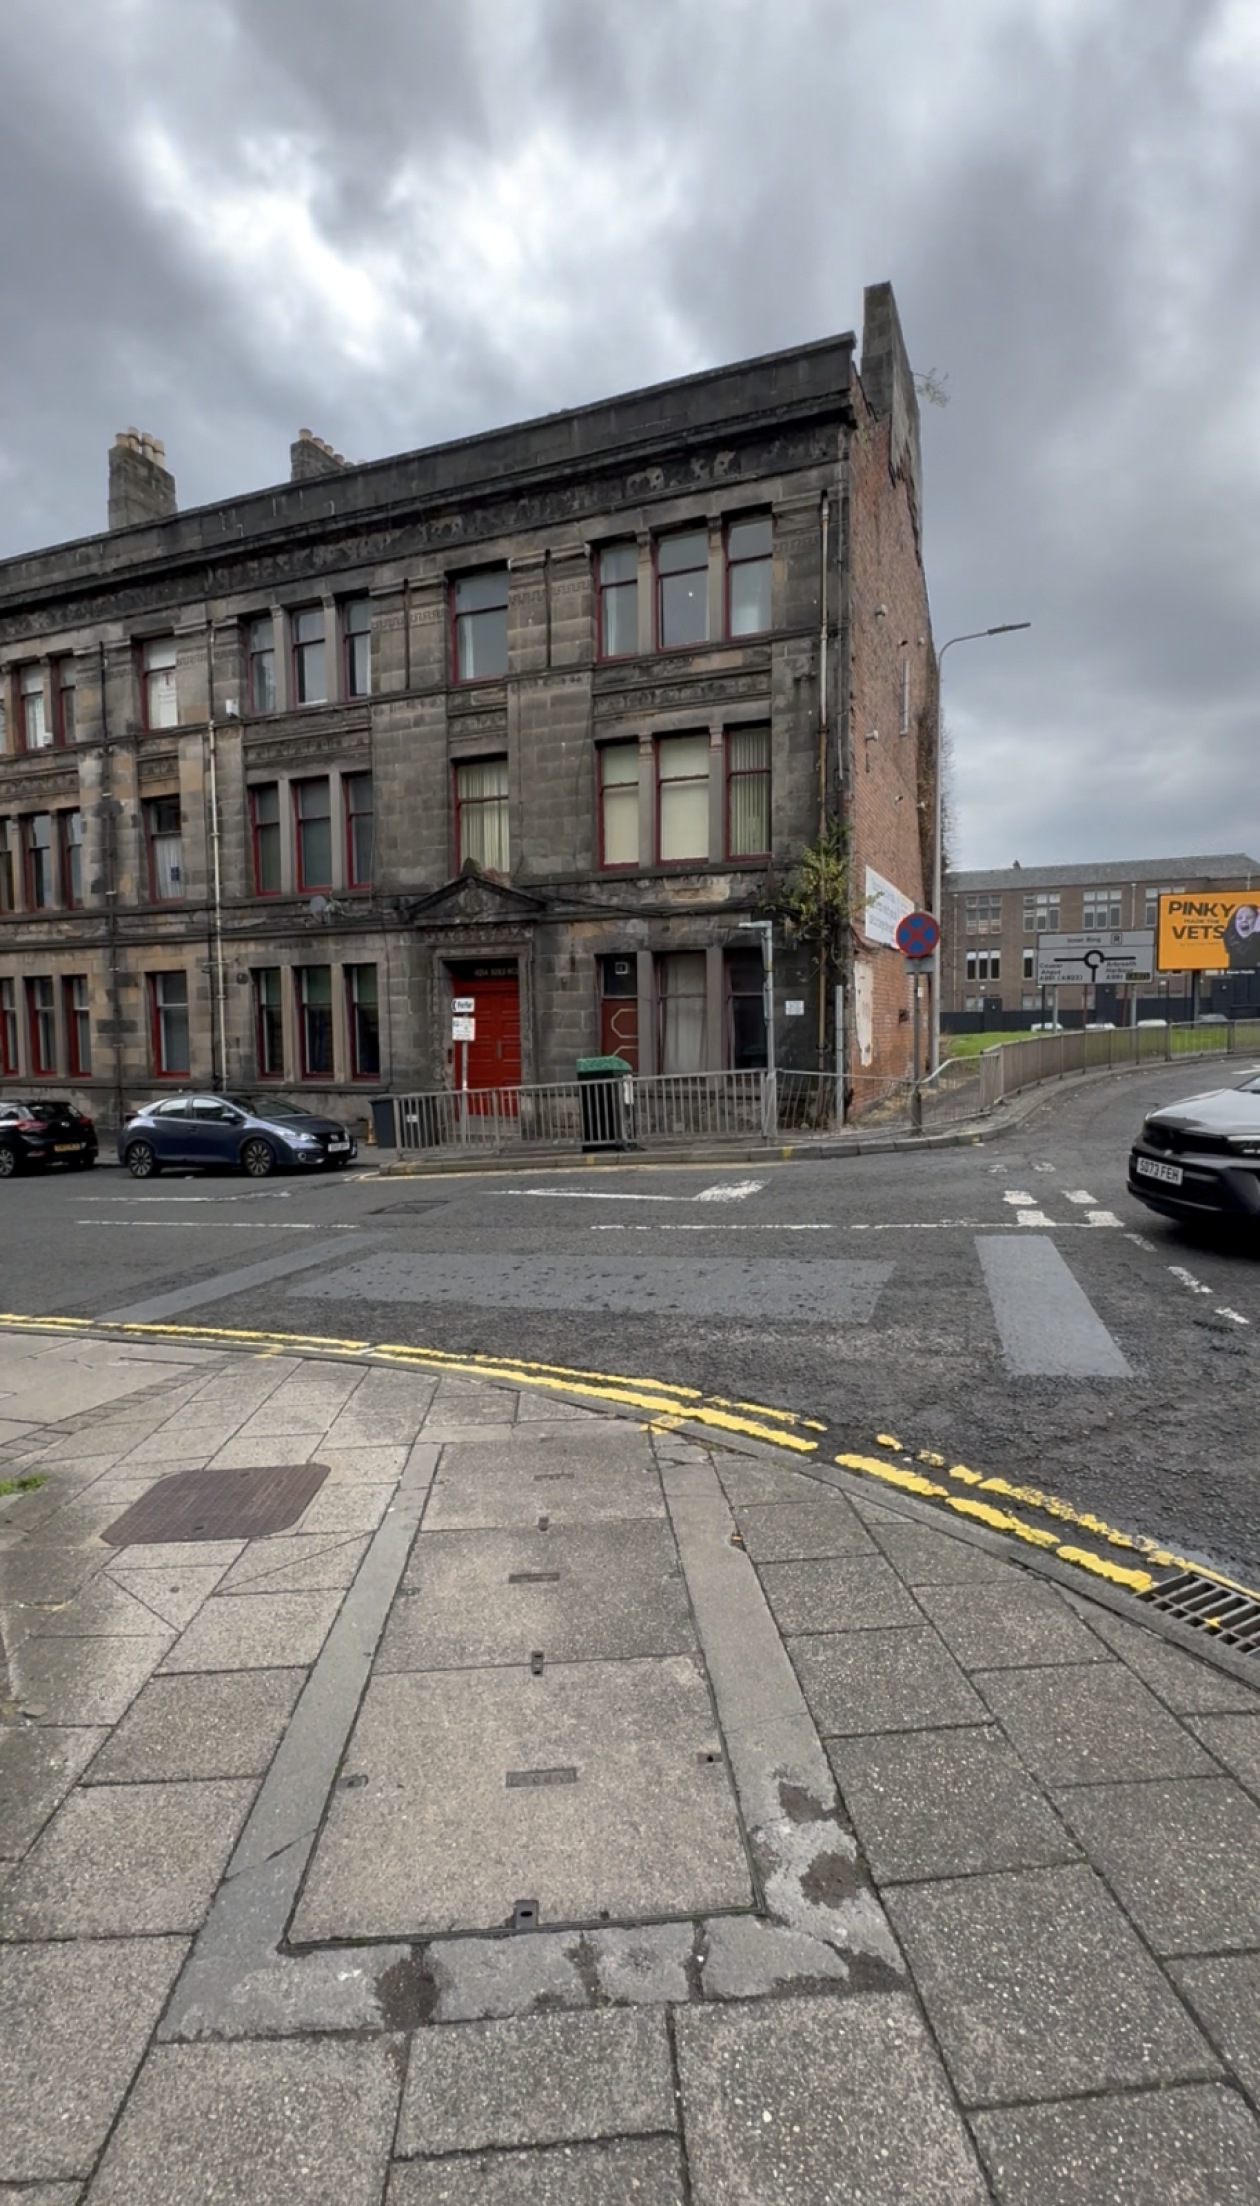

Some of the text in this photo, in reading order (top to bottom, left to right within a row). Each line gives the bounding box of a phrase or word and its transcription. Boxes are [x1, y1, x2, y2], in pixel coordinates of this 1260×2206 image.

[1168, 901, 1236, 918] PINKY
[1172, 925, 1225, 940] VETS
[1161, 1165, 1180, 1182] FEH
